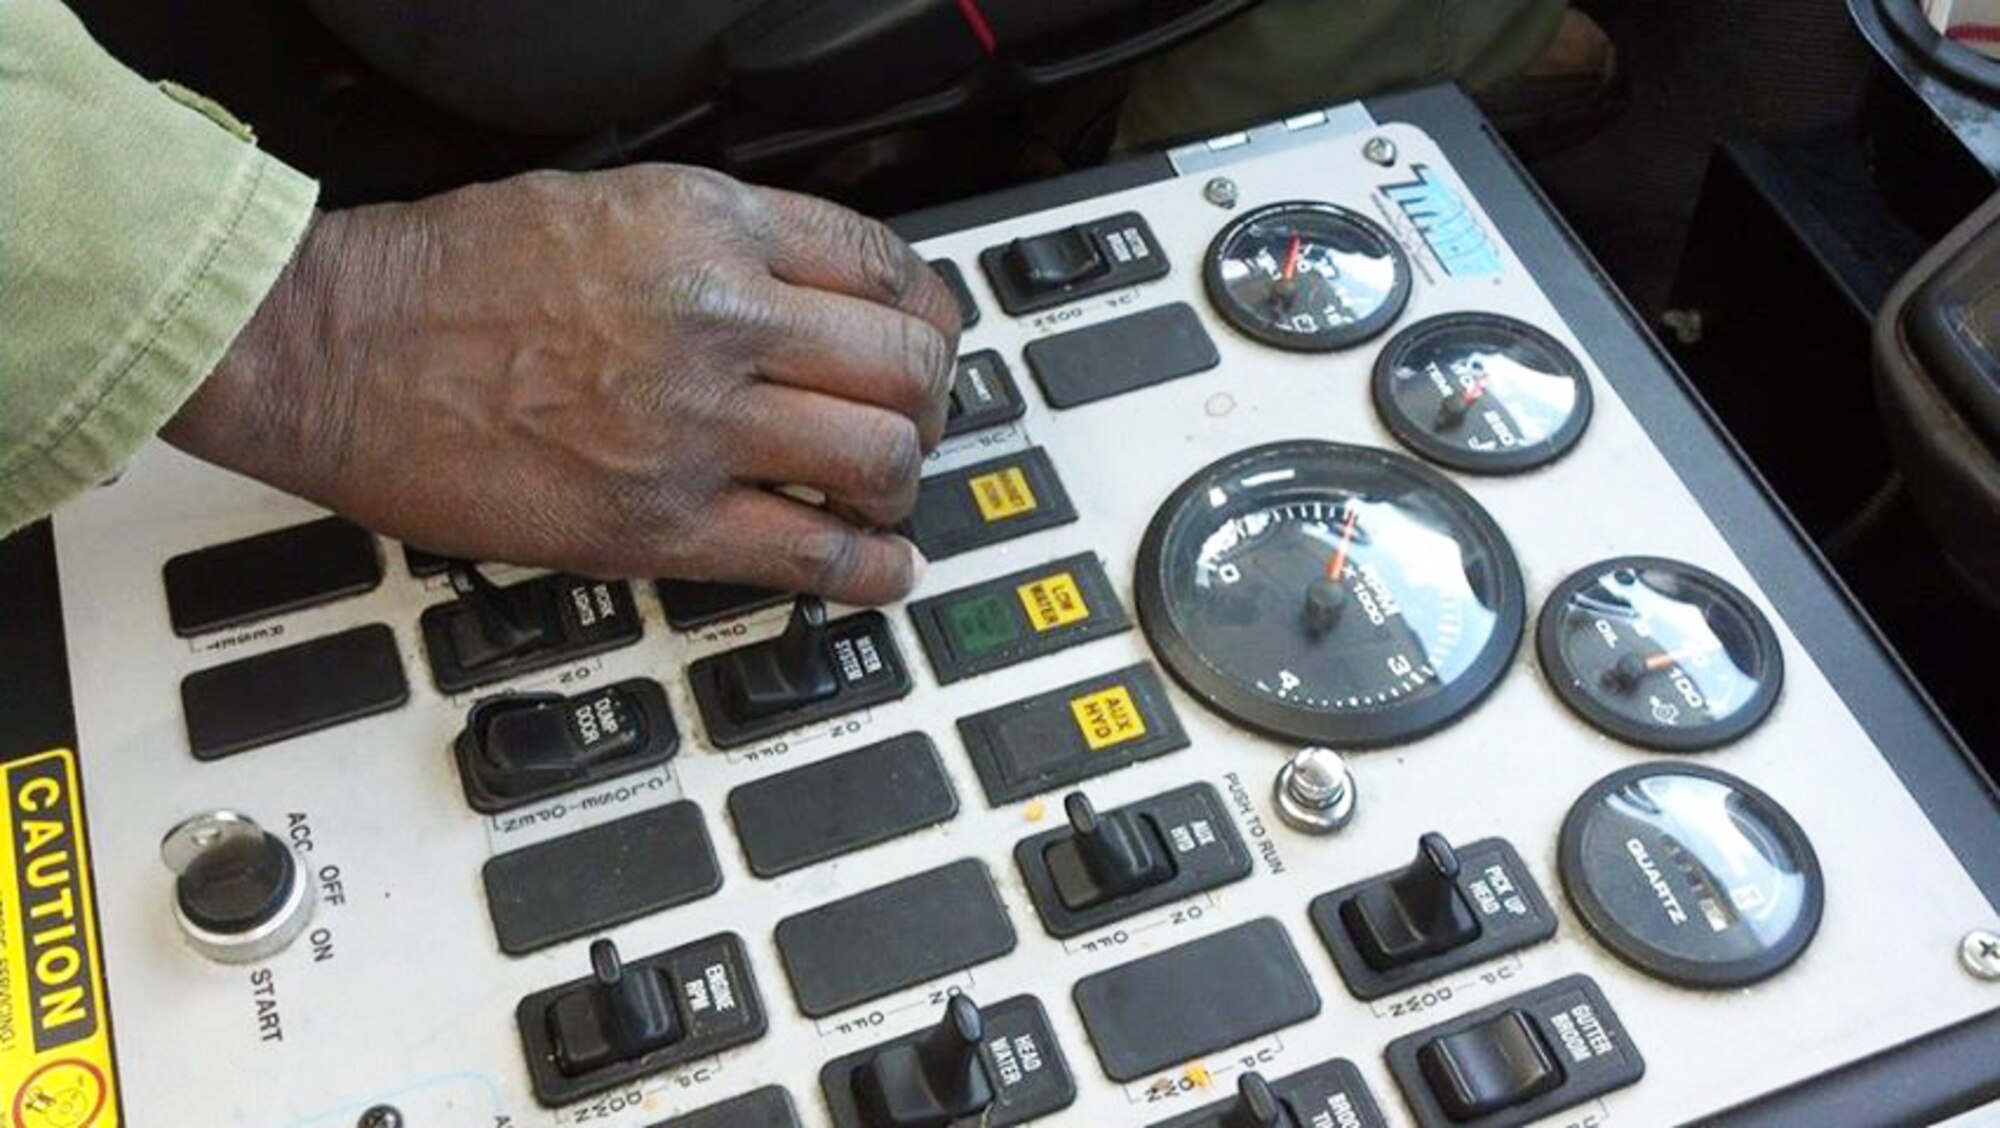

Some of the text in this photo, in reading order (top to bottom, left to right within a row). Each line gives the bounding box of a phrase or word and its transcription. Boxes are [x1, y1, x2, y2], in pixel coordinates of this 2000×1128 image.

[1353, 582, 1385, 626] 1000
[1595, 619, 1618, 648] OIL
[1278, 669, 1300, 690] 4
[1387, 654, 1411, 676] 3
[1669, 667, 1703, 708] 100
[575, 704, 600, 745] DOOR
[594, 697, 619, 734] DUMP
[1083, 702, 1113, 739] HYD
[1106, 698, 1134, 732] AUX
[745, 720, 861, 761] ON OFF
[287, 811, 313, 851] ACC
[1224, 772, 1287, 875] PUSH TO RUN
[319, 864, 345, 906] OFF
[1470, 879, 1500, 915] HEAD
[1484, 864, 1527, 916] PICK UP
[1626, 838, 1688, 926] QUARTZ
[18, 777, 86, 1029] CAUTION
[310, 928, 334, 962] ON
[1082, 905, 1203, 952] ON OFF
[250, 969, 283, 1042] START
[1390, 966, 1514, 1018] UP DOWN
[835, 1011, 885, 1034] OFF
[1550, 1013, 1593, 1063] BROOM
[1571, 1003, 1613, 1056] GUTTER
[989, 1036, 1023, 1086] WATER
[1014, 1033, 1042, 1073] HEAD
[1239, 1048, 1273, 1068] UP
[674, 1068, 712, 1088] UP
